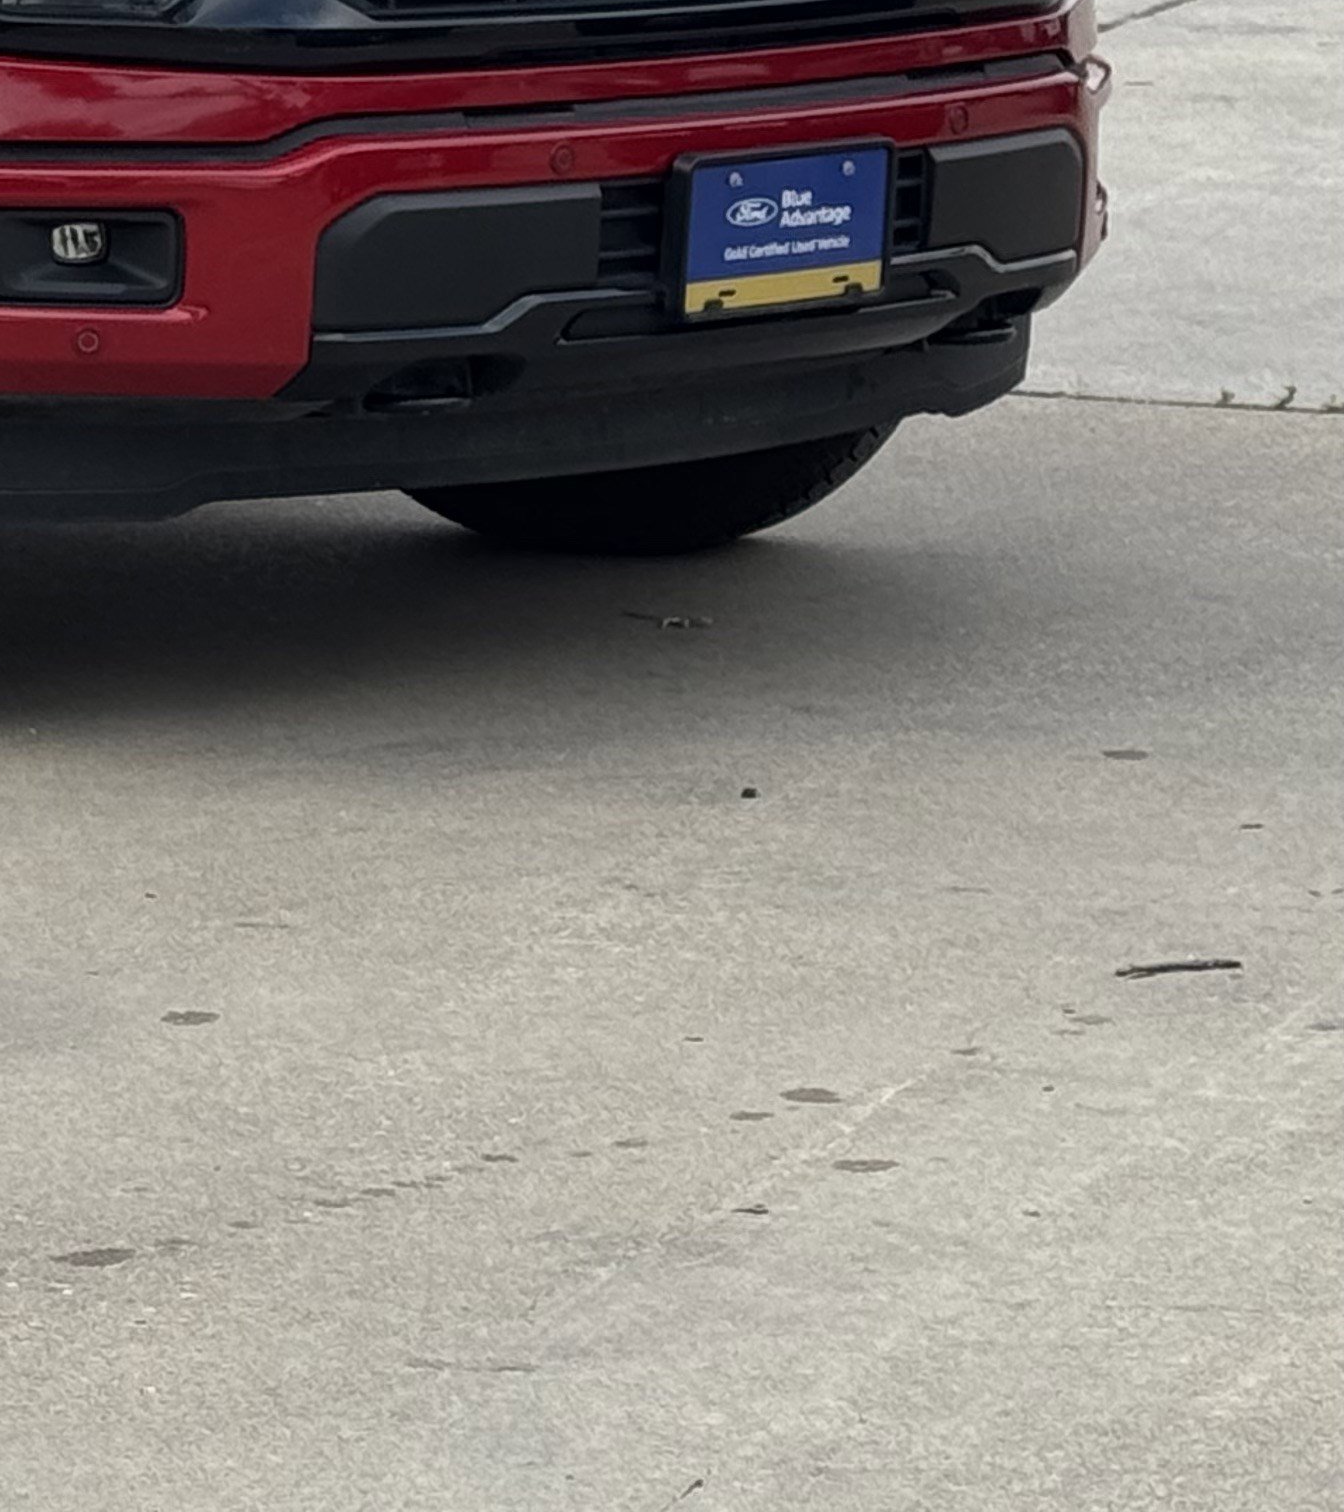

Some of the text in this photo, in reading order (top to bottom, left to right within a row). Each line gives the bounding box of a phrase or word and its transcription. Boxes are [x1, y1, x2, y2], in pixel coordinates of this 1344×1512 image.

[780, 189, 812, 208] Blue
[735, 201, 770, 222] Ford
[779, 205, 852, 228] Advantage
[723, 246, 749, 261] Gold
[749, 240, 789, 259] Certified
